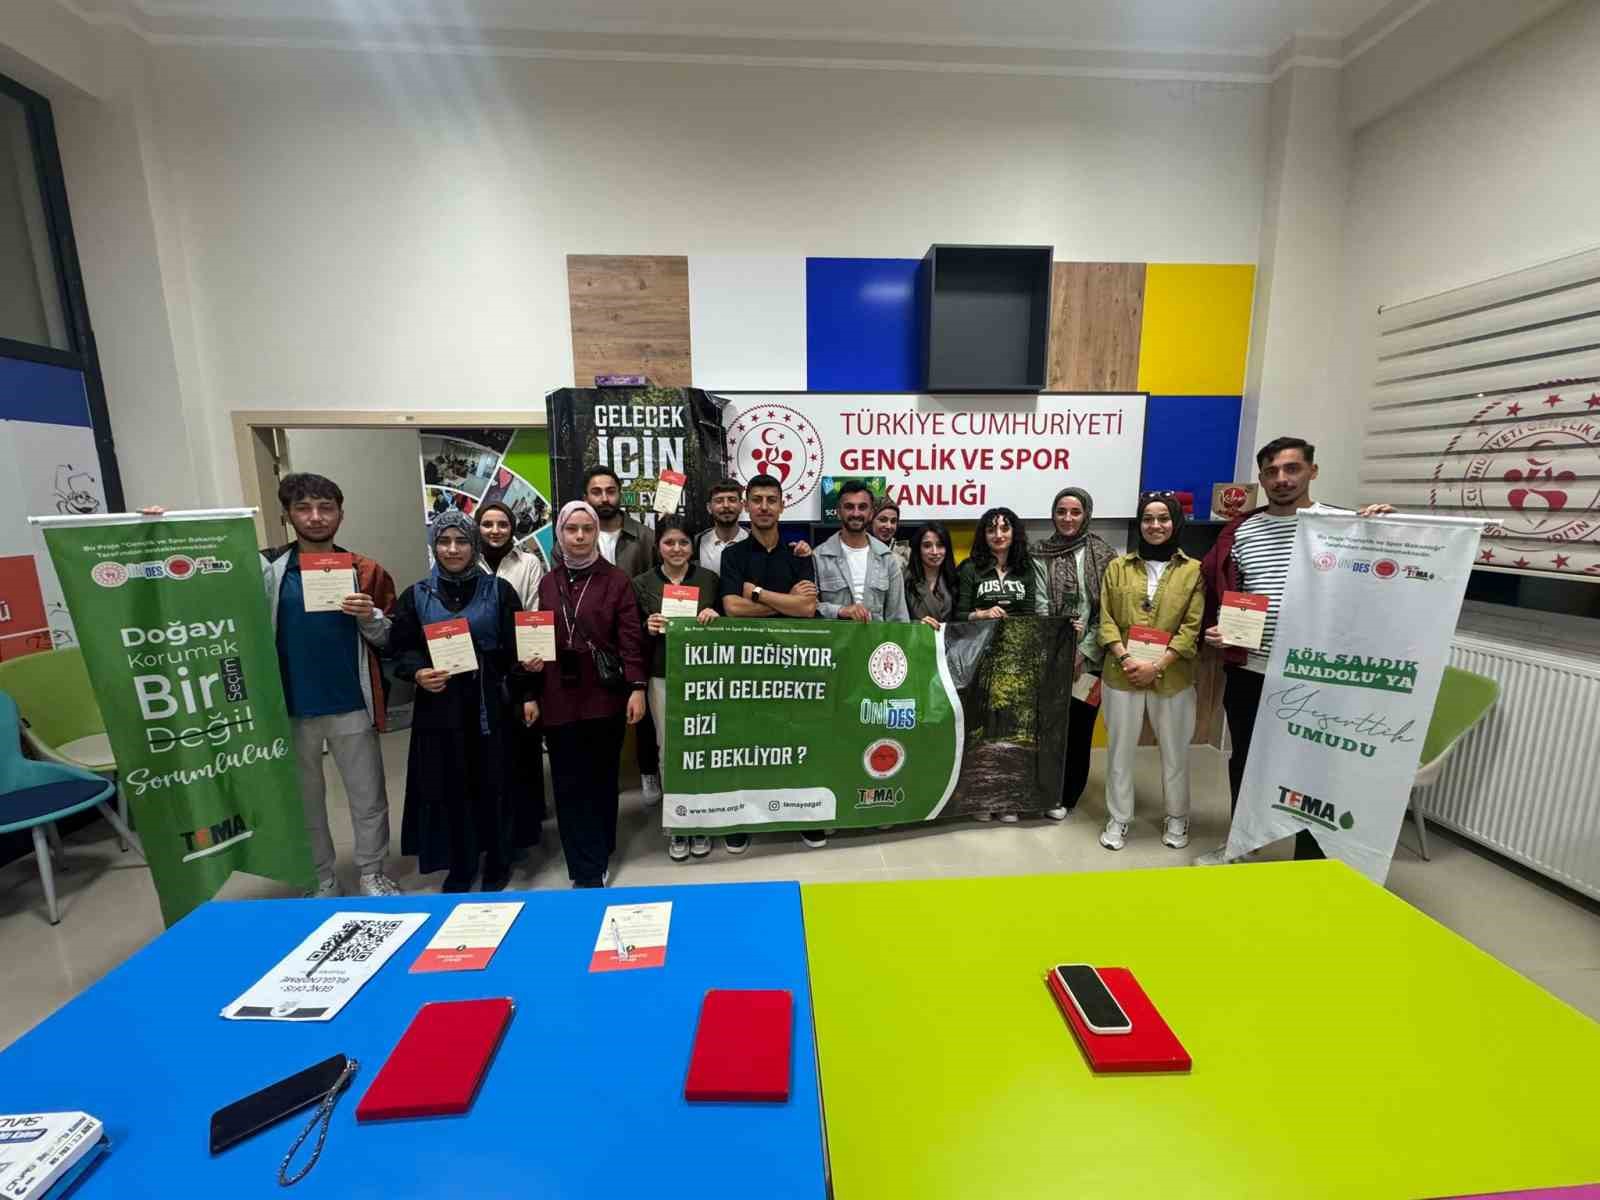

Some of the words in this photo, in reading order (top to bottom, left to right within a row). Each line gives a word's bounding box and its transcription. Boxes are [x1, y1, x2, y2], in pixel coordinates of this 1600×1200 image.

[594, 405, 684, 428] GELECEK
[840, 408, 945, 435] TÜRKİYE
[951, 408, 1122, 435] CUMHURİYETİ
[840, 443, 957, 477] GENÇLİK
[961, 448, 993, 470] VE
[1000, 448, 1070, 470] SPOR
[120, 618, 236, 648] Doğayı
[127, 639, 239, 669] Korumak
[684, 643, 735, 666] İKLİM
[741, 643, 837, 670] DEĞİŞİYOR,
[1286, 647, 1328, 666] KÖK
[1335, 653, 1419, 672] SALDIK
[133, 666, 220, 721] Bir
[684, 677, 724, 701] PEKİ
[729, 680, 826, 700] GELECEKTE
[146, 705, 255, 753] Değil
[683, 712, 717, 736] BİZİ
[1287, 721, 1377, 758] UMUDU
[126, 737, 288, 796] Sorumluluk
[683, 751, 705, 770] NE
[710, 745, 793, 769] BEKLİYOR
[797, 746, 808, 764] ?
[858, 787, 894, 803] TEMA
[1278, 785, 1336, 822] TEMA
